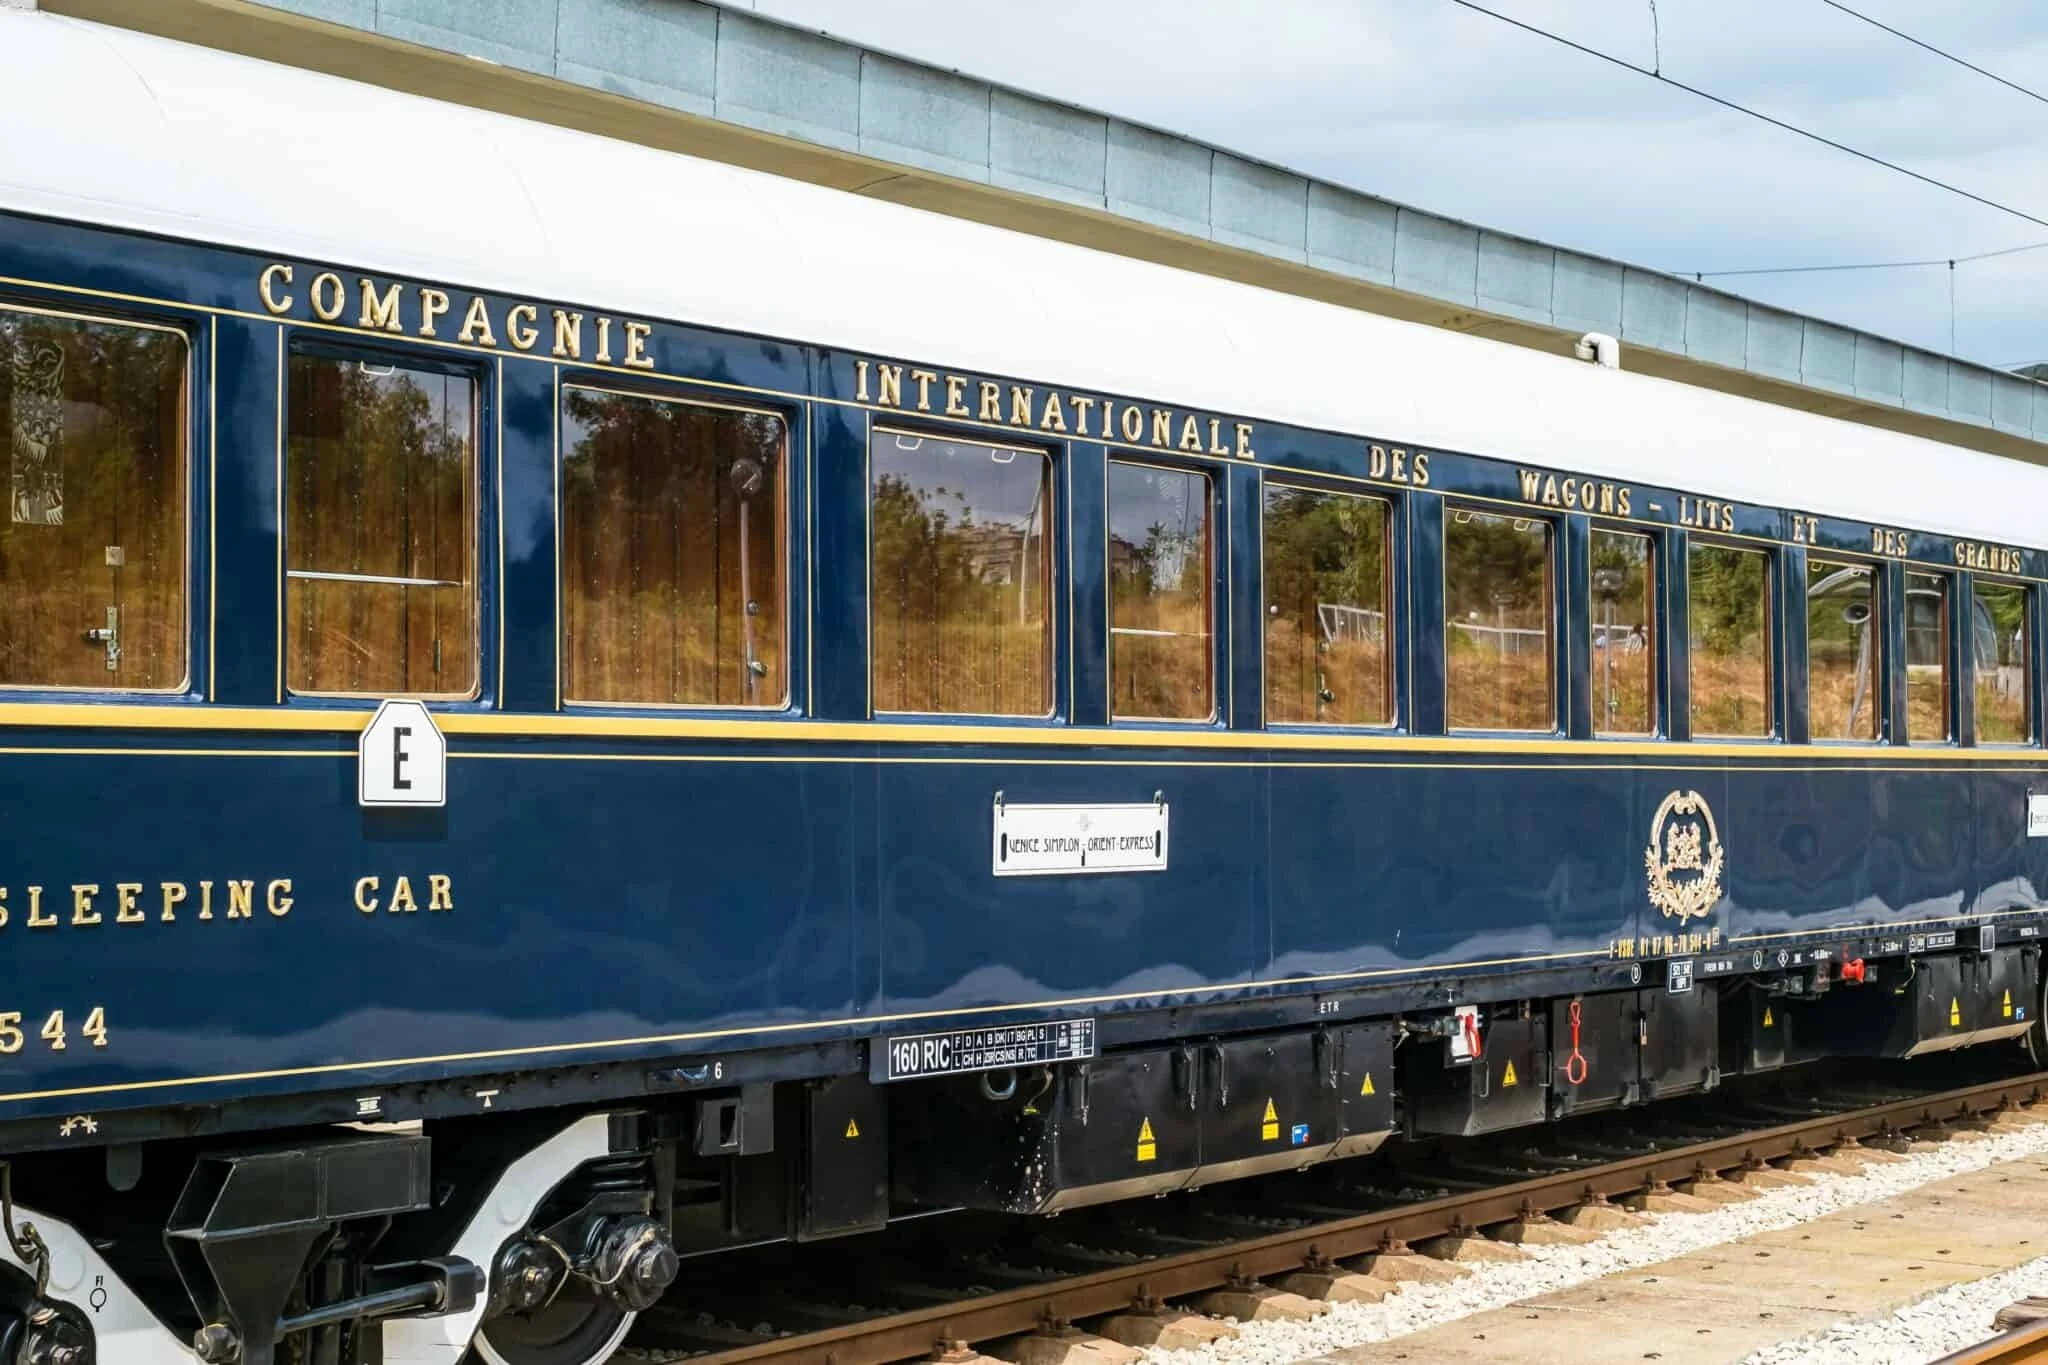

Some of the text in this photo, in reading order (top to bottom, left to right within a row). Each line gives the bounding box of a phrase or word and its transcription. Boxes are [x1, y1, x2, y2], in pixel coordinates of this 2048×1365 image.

[259, 264, 654, 369] COMPAGNIE
[854, 360, 1256, 460] INTERNATIONALE
[1368, 445, 1430, 487] DES
[1518, 470, 1632, 517] WAGONS
[1679, 496, 1735, 531] LITS
[1792, 516, 1820, 544] ET
[1871, 528, 1908, 557] DES
[1955, 541, 2021, 573] GRANDS
[392, 727, 412, 790] E
[1009, 838, 1040, 853] VENICE
[1044, 836, 1080, 852] SIMPLON
[354, 874, 454, 914] CAR
[1320, 1000, 1340, 1014] ETR
[0, 1006, 108, 1054] 544
[954, 1034, 961, 1047] F
[964, 1033, 972, 1046] D
[975, 1032, 983, 1046] A
[714, 1062, 722, 1079] 6
[893, 1038, 950, 1073] 160 RIC
